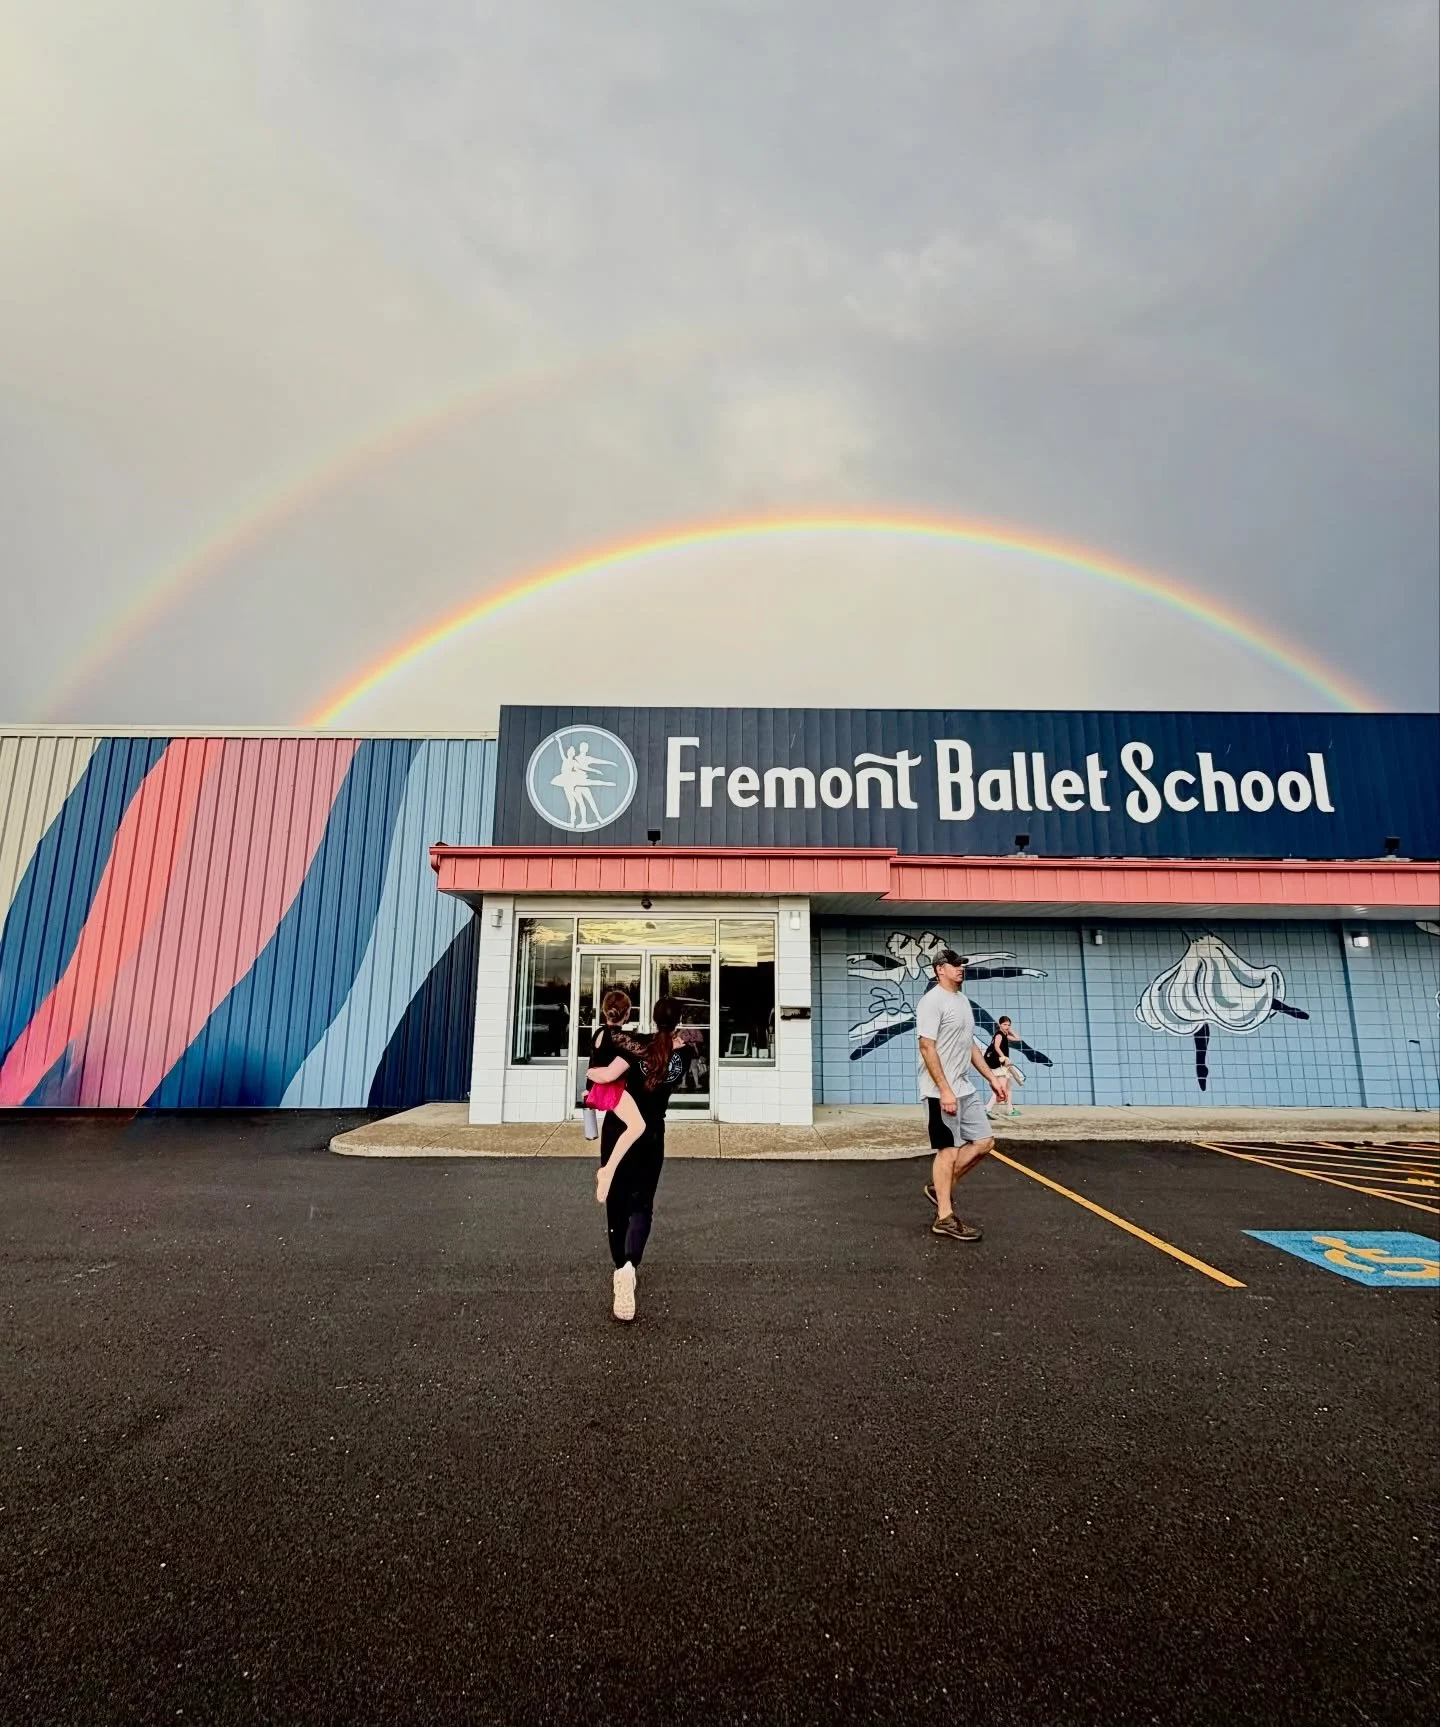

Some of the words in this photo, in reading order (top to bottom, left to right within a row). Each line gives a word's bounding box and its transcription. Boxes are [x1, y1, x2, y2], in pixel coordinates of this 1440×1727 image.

[665, 736, 921, 818] Fremont
[934, 739, 1110, 821] Ballet
[1121, 741, 1335, 824] School
